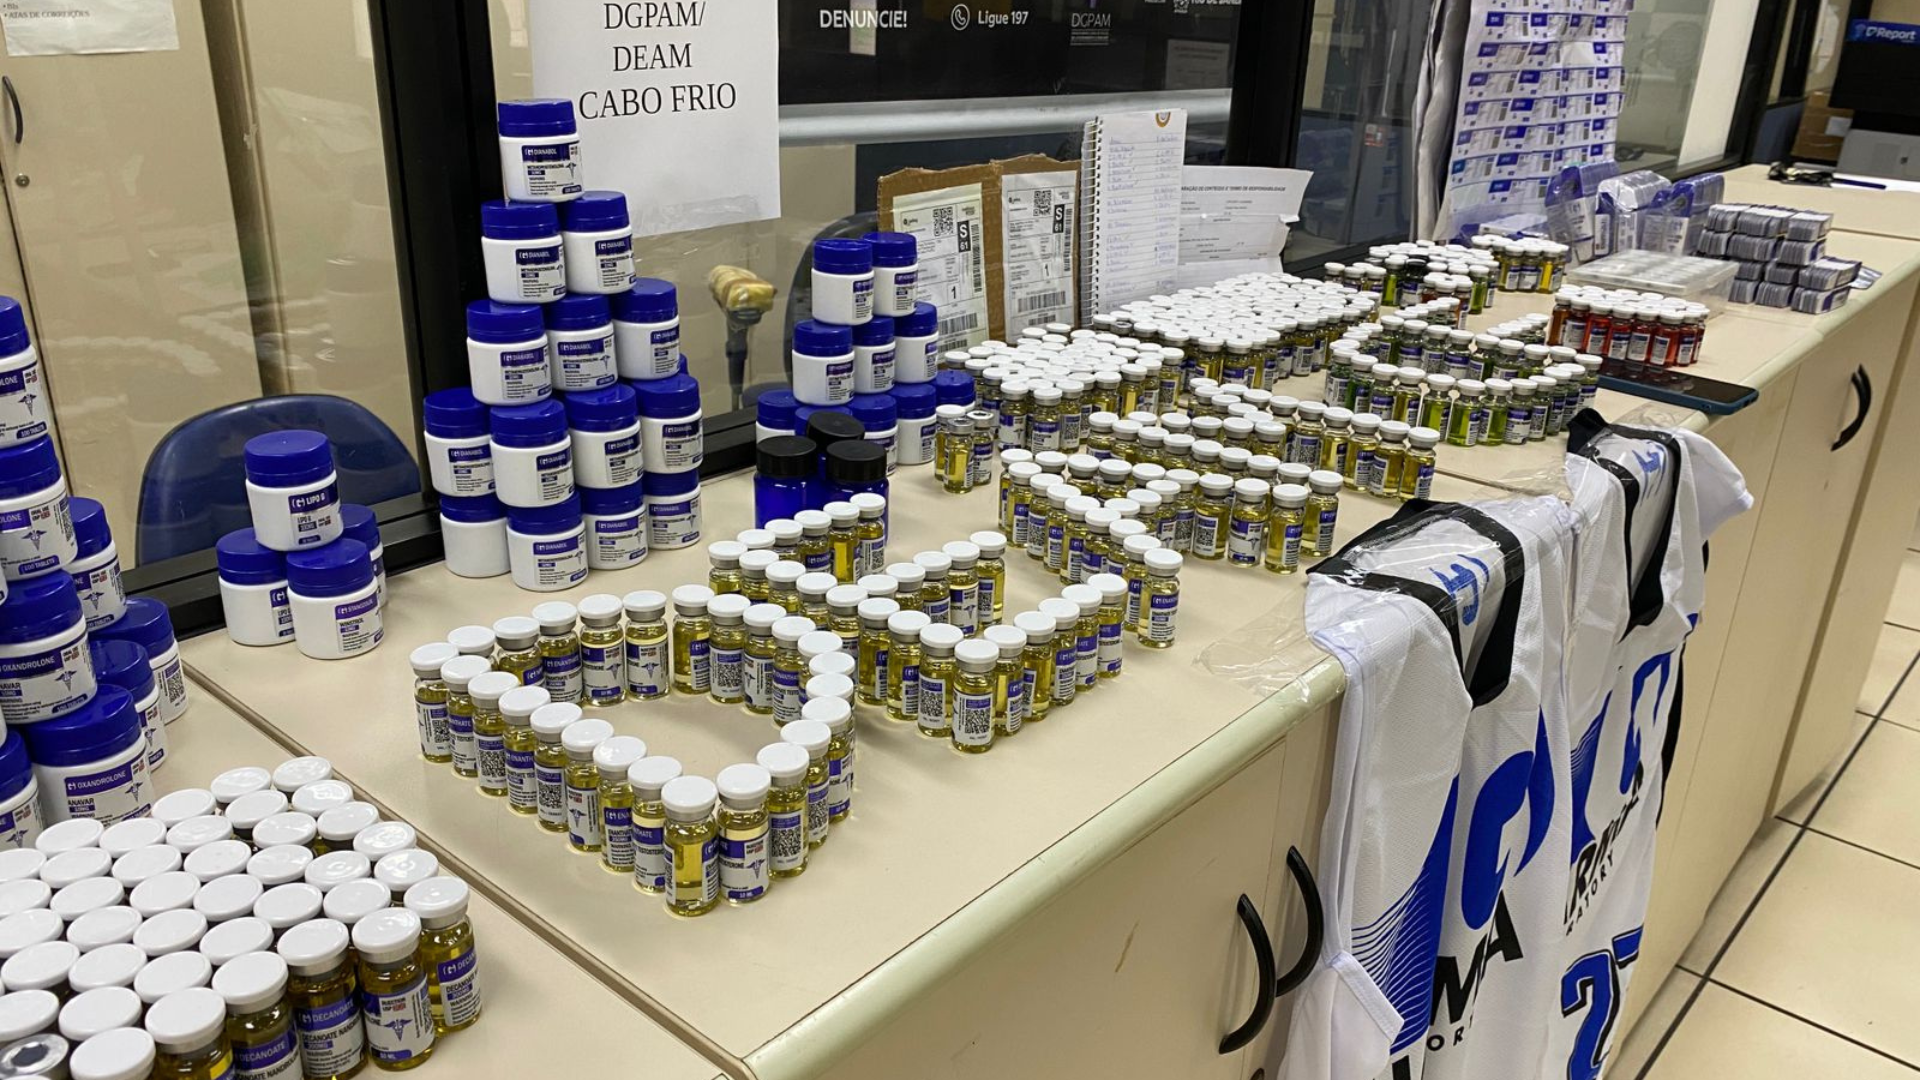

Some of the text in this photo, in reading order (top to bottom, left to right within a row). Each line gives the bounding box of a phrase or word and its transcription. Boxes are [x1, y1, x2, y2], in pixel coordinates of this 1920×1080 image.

[604, 2, 706, 30] DGPAM/
[819, 9, 908, 29] DENUNCIE!
[977, 10, 1029, 28] Ligue 197
[613, 43, 693, 72] DEAM
[579, 82, 737, 120] CABO FRIO
[1055, 207, 1063, 221] S
[959, 224, 968, 239] S
[959, 241, 969, 251] 61
[306, 496, 320, 505] LIPO
[2, 655, 55, 672] OXANDROLONE
[77, 769, 126, 790] OXANDROLONE
[68, 798, 95, 806] ANAVAR
[312, 998, 353, 1022] DECANOATE
[239, 1040, 286, 1063] DECANOATE
